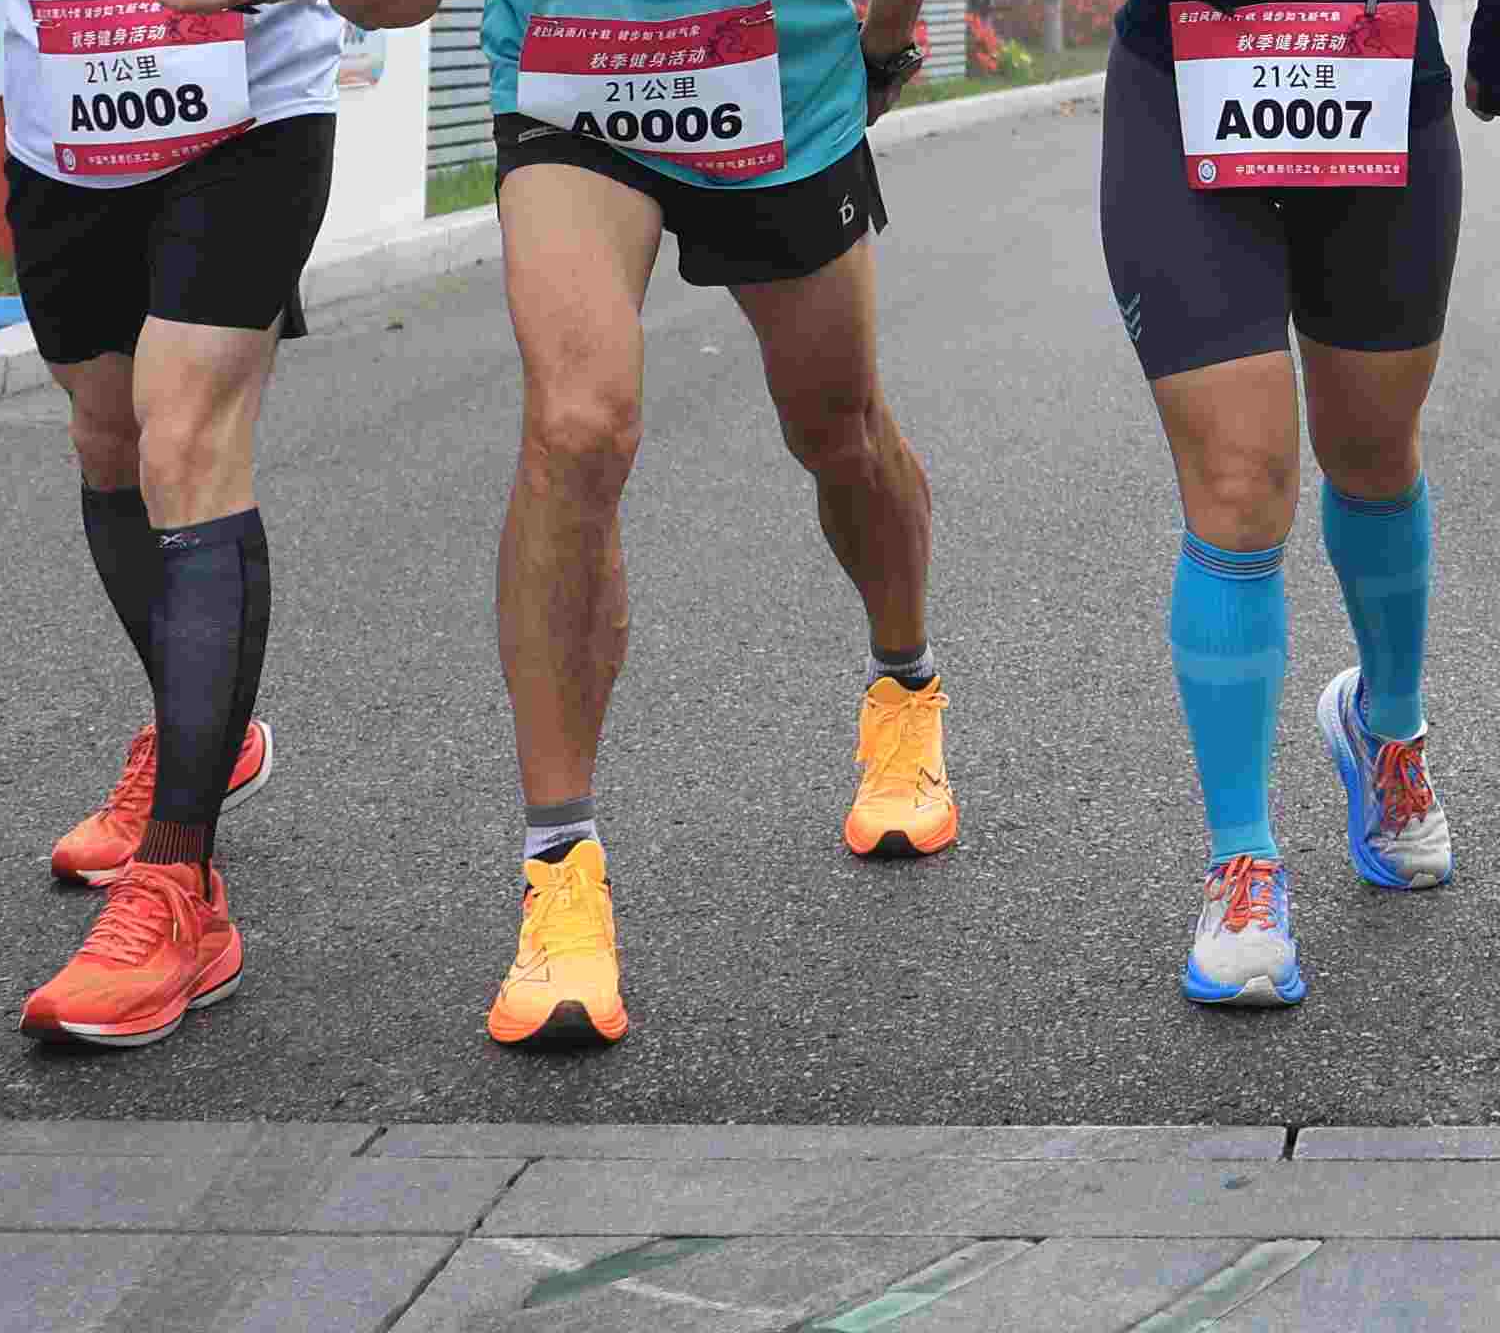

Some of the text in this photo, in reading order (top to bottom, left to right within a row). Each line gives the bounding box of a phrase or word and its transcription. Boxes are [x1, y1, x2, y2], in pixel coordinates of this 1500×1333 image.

[1236, 32, 1347, 52] 秋季健身活动
[85, 54, 161, 84] 21公里
[589, 46, 706, 69] 秋季健身活动
[605, 76, 698, 102] 21公里
[1253, 64, 1337, 89] 21公里
[71, 83, 208, 133] A0008
[1215, 98, 1373, 140] A0007
[571, 102, 743, 144] A0006
